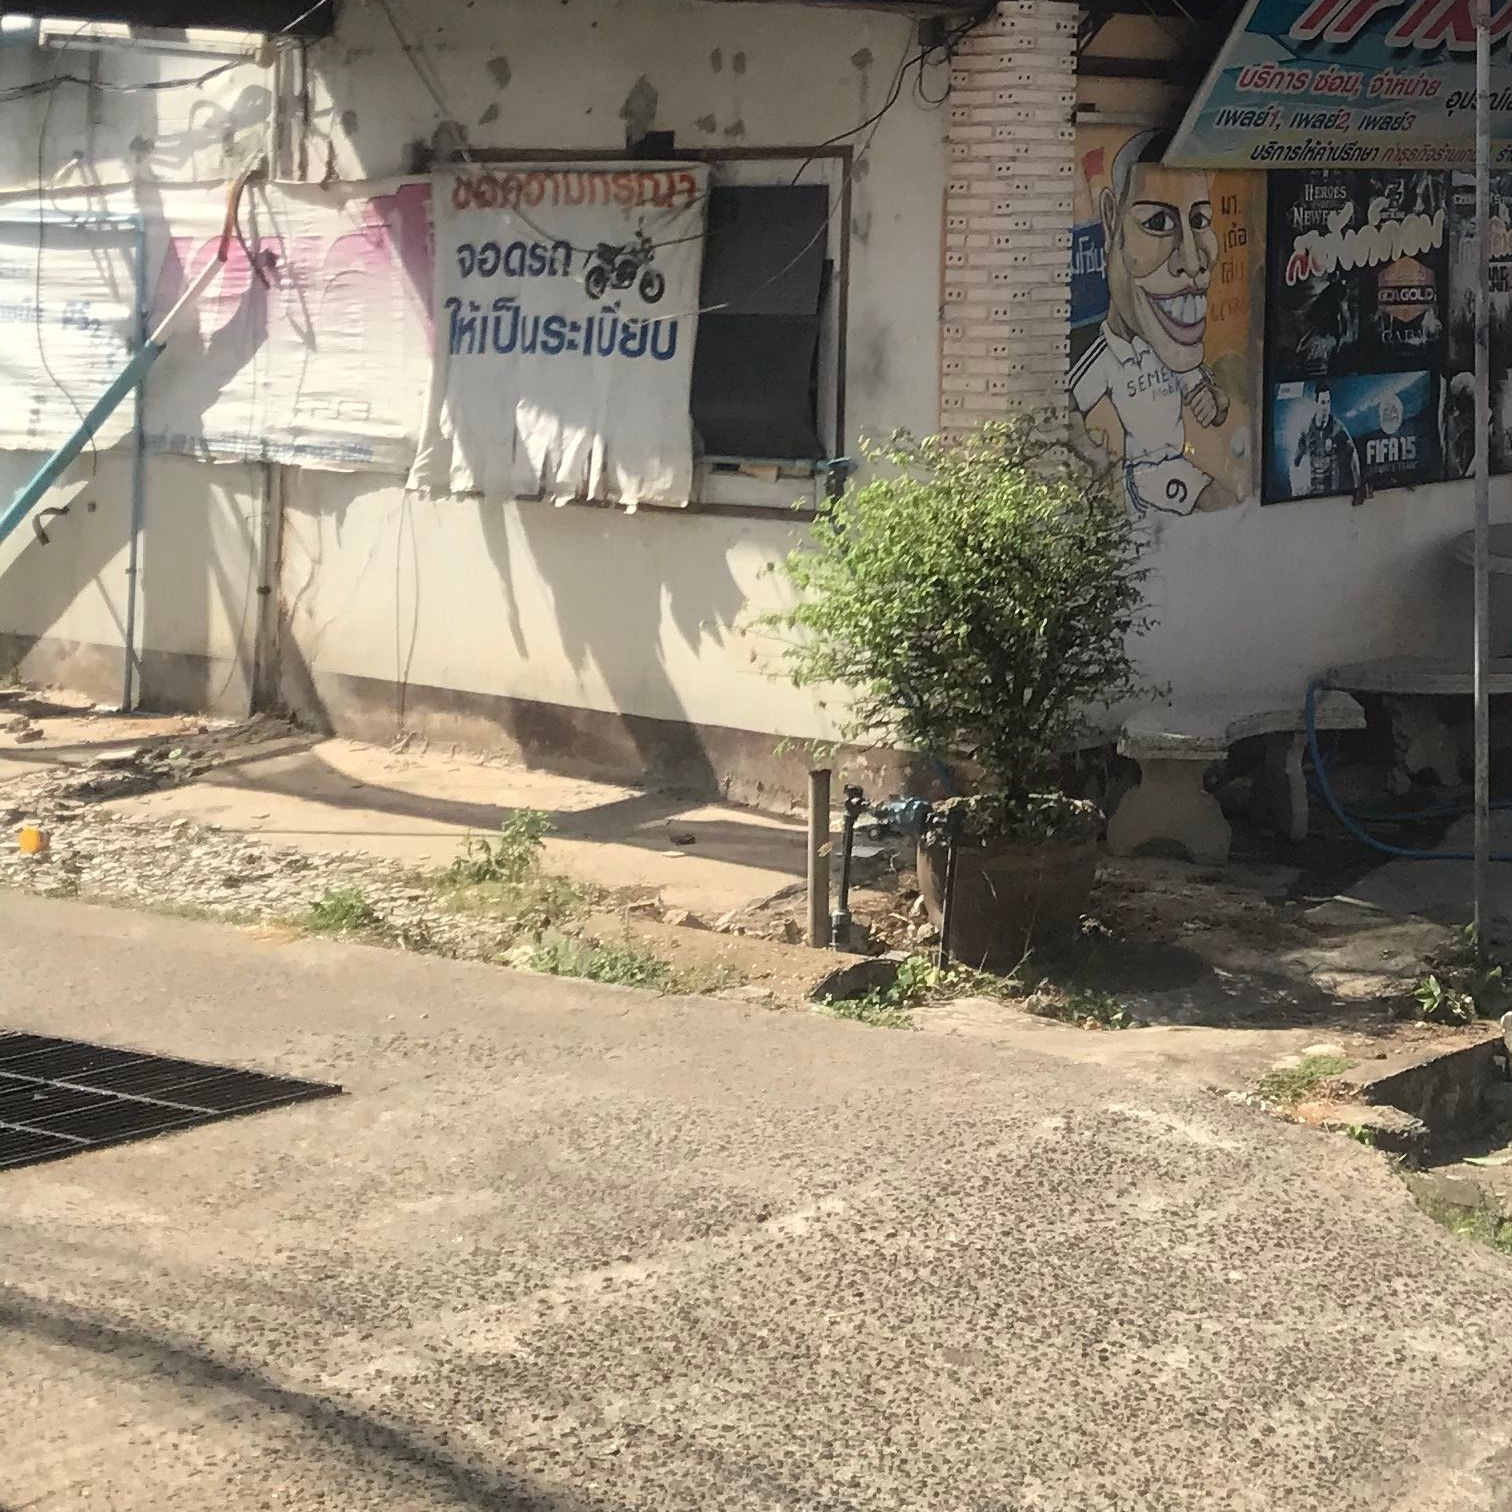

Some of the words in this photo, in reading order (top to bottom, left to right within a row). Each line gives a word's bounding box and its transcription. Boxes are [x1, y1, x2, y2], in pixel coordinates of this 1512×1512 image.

[1238, 63, 1310, 92] บริการ
[1369, 68, 1442, 97] จำหน่าย
[456, 240, 573, 278] จอดรถ
[445, 296, 680, 361] ให้เป็นระเบียบ
[1366, 437, 1399, 465] FIFA
[1400, 435, 1417, 461] 15
[1165, 478, 1188, 503] 9
